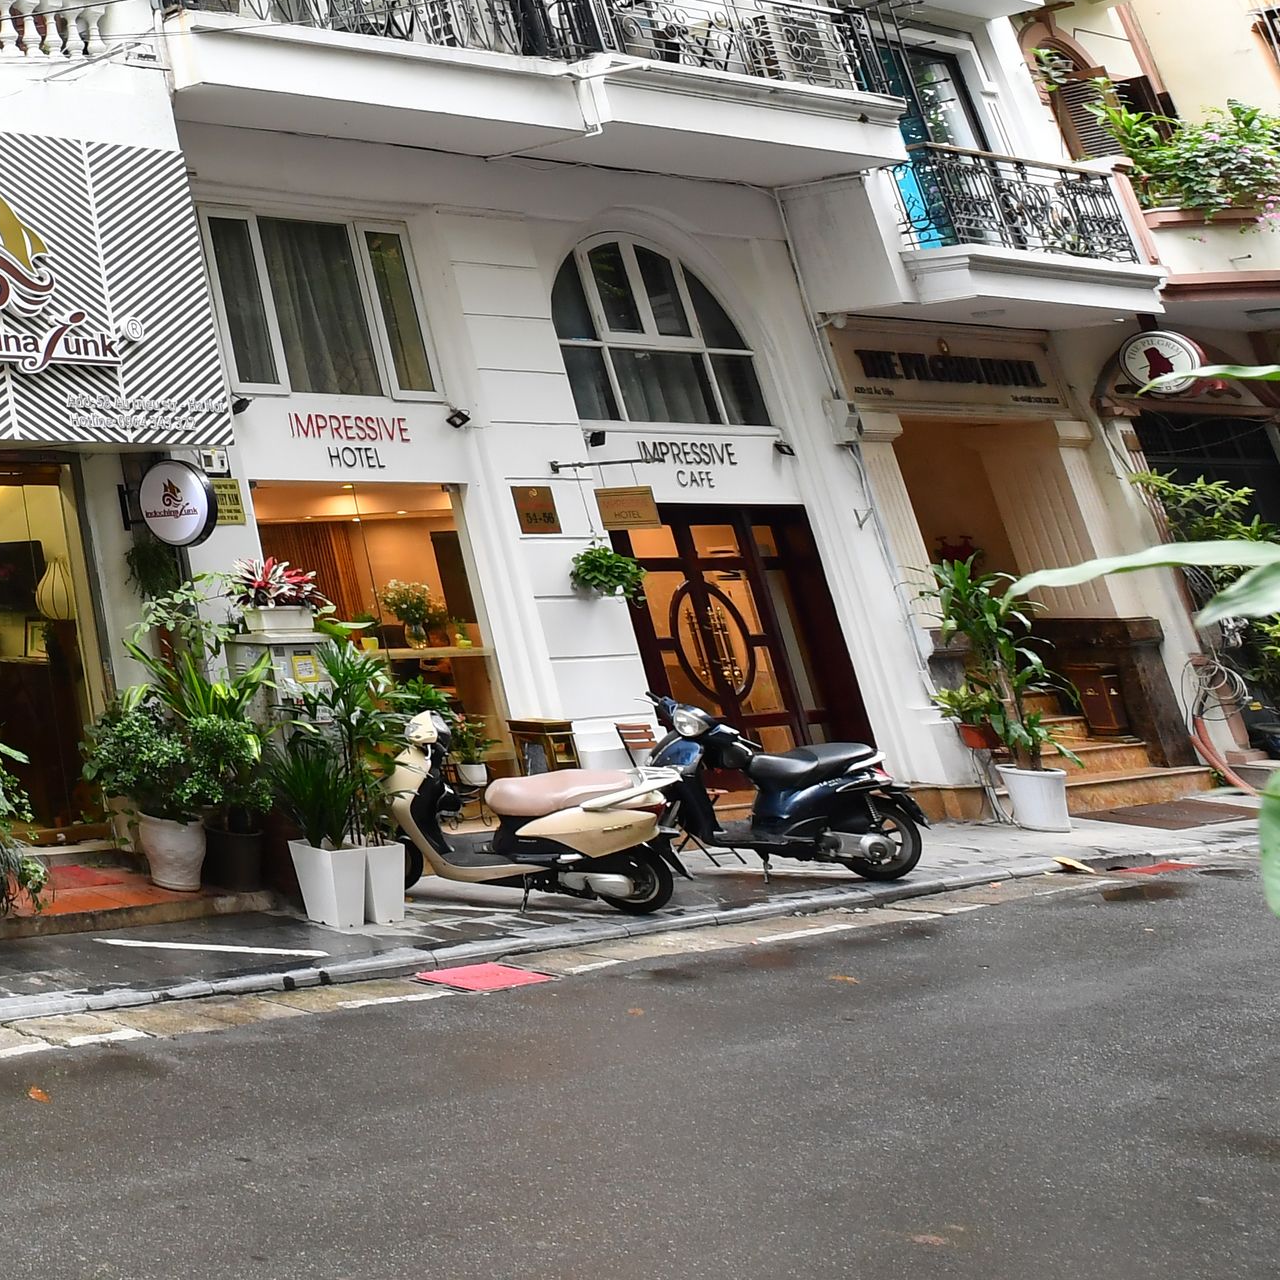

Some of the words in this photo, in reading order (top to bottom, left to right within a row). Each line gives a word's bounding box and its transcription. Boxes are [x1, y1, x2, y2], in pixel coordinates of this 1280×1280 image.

[288, 412, 411, 442] IMPRESSIVE
[327, 446, 386, 468] HOTEL
[637, 440, 738, 466] IMPRESSIVE
[676, 470, 716, 489] CAFE
[614, 510, 642, 520] HOTEL
